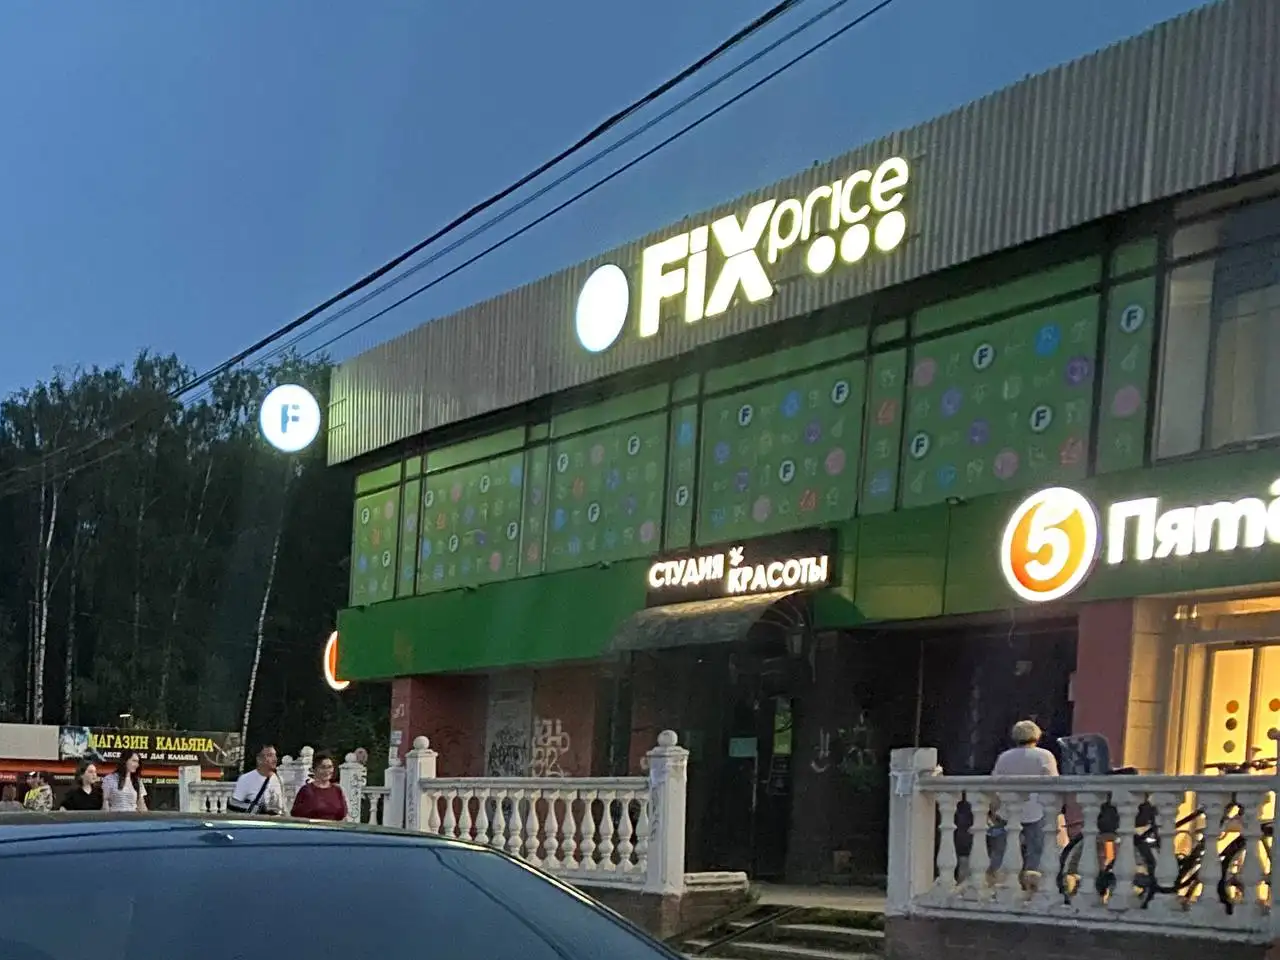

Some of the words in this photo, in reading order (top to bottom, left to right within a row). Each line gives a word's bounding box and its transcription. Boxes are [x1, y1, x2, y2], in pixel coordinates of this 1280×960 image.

[1023, 488, 1079, 582] 5
[1106, 478, 1280, 565] Пят
[648, 553, 725, 589] СТУДИЯ
[726, 554, 829, 594] КРАСОТЫ
[88, 732, 149, 750] МАГАЗИН
[155, 736, 215, 752] КАЛЬЯНА
